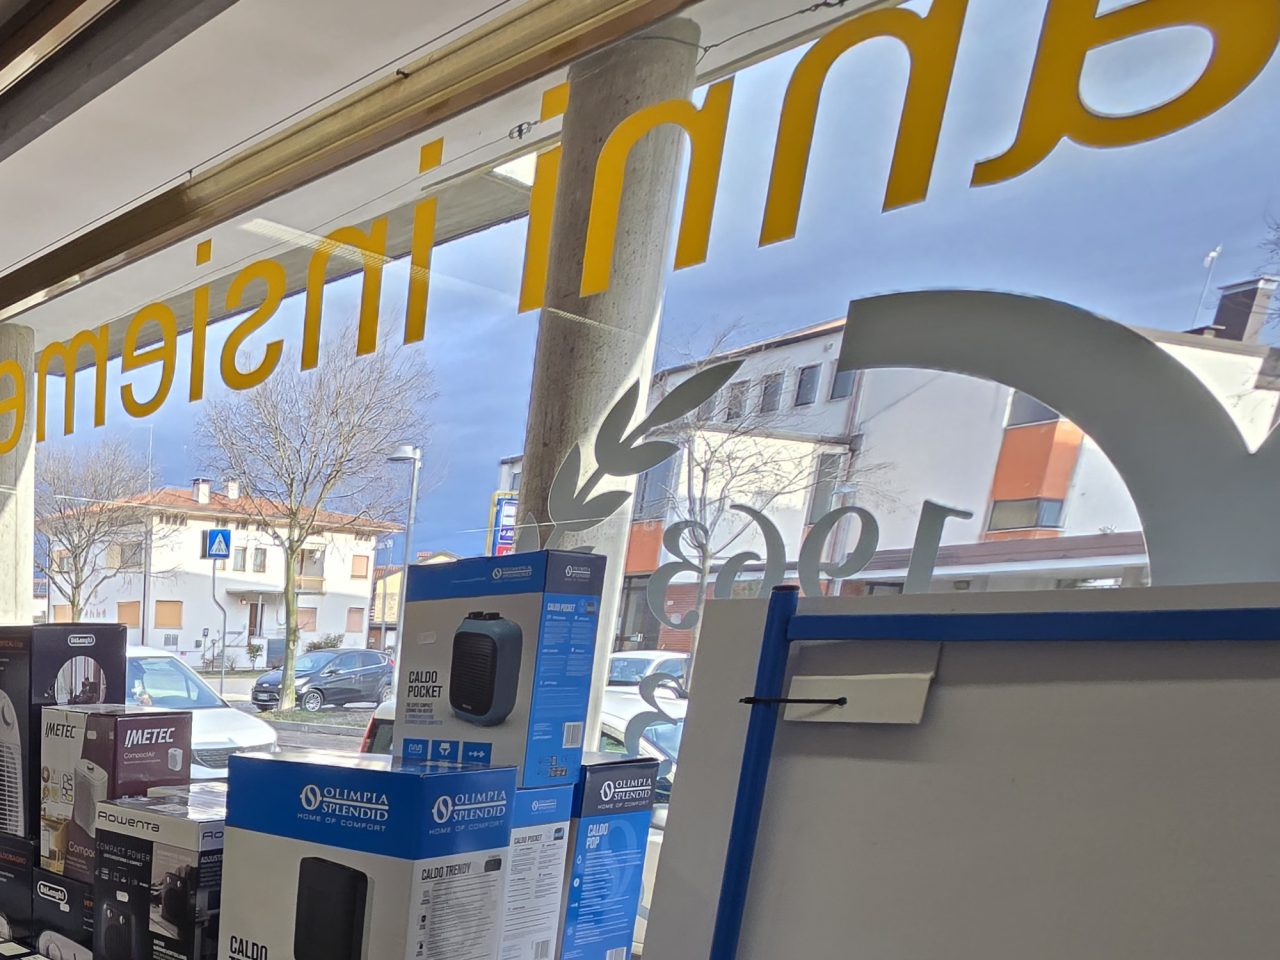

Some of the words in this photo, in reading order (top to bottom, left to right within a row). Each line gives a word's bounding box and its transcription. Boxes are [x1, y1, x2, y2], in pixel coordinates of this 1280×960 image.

[409, 671, 437, 684] CALDO
[407, 685, 443, 698] POCKET
[45, 722, 76, 739] IMETEC
[124, 728, 175, 747] IMETEC
[615, 778, 652, 788] OLIMPIA
[323, 787, 389, 805] OLIMPIA
[455, 790, 506, 805] OLIMPIA
[614, 790, 651, 800] SPLENDID
[322, 803, 389, 822] SPLENDID
[453, 806, 506, 822] SPLENDID
[297, 813, 321, 823] HOME
[340, 819, 386, 832] COMFORT
[429, 827, 451, 835] HOME
[468, 820, 504, 831] COMFORT
[588, 823, 608, 836] CALDO
[586, 837, 599, 848] POP
[127, 850, 150, 862] POWER
[422, 866, 444, 881] CALDO
[445, 862, 471, 877] TRENDY
